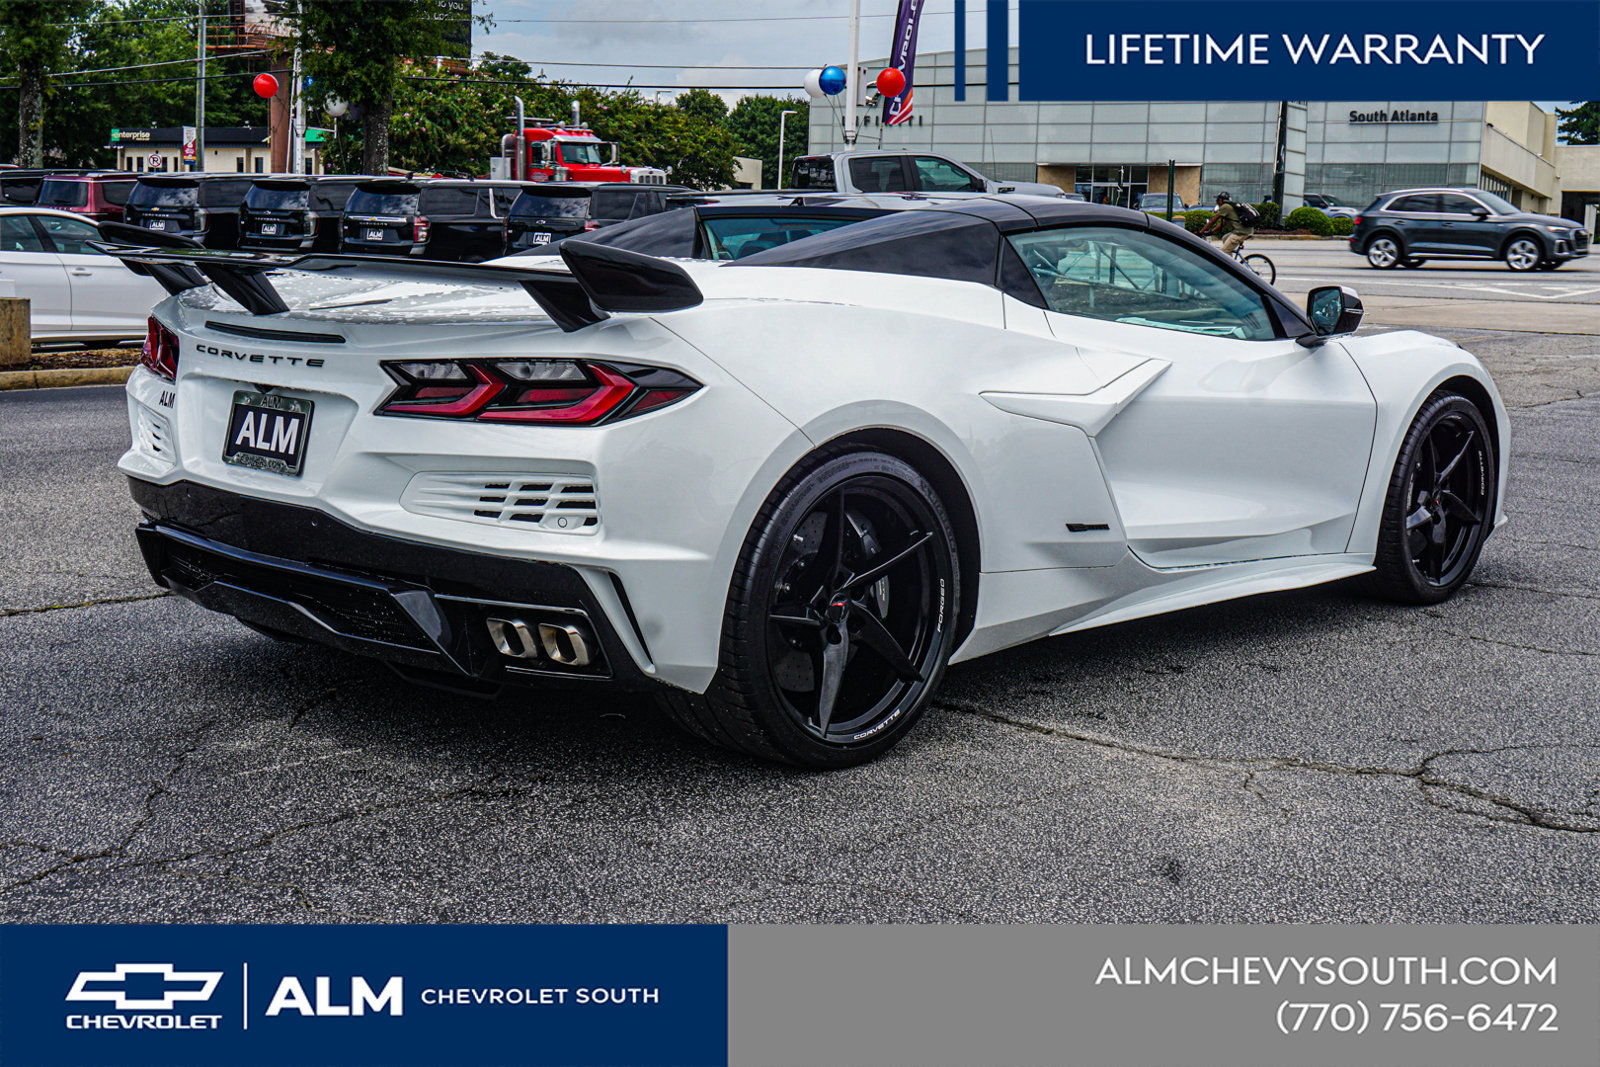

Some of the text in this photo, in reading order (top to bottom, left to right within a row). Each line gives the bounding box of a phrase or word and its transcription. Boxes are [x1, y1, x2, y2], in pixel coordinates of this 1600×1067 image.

[889, 0, 918, 116] CVROLE
[842, 115, 923, 127] IFITI
[1349, 109, 1439, 122] South Atlanta
[112, 130, 151, 140] enterprise
[535, 234, 549, 242] ALM
[196, 344, 325, 368] CORVETTE
[158, 390, 175, 409] ALM
[260, 395, 283, 409] ALM
[235, 411, 300, 455] ALM
[937, 578, 945, 633] FORGED
[853, 708, 901, 740] CORVETTE
